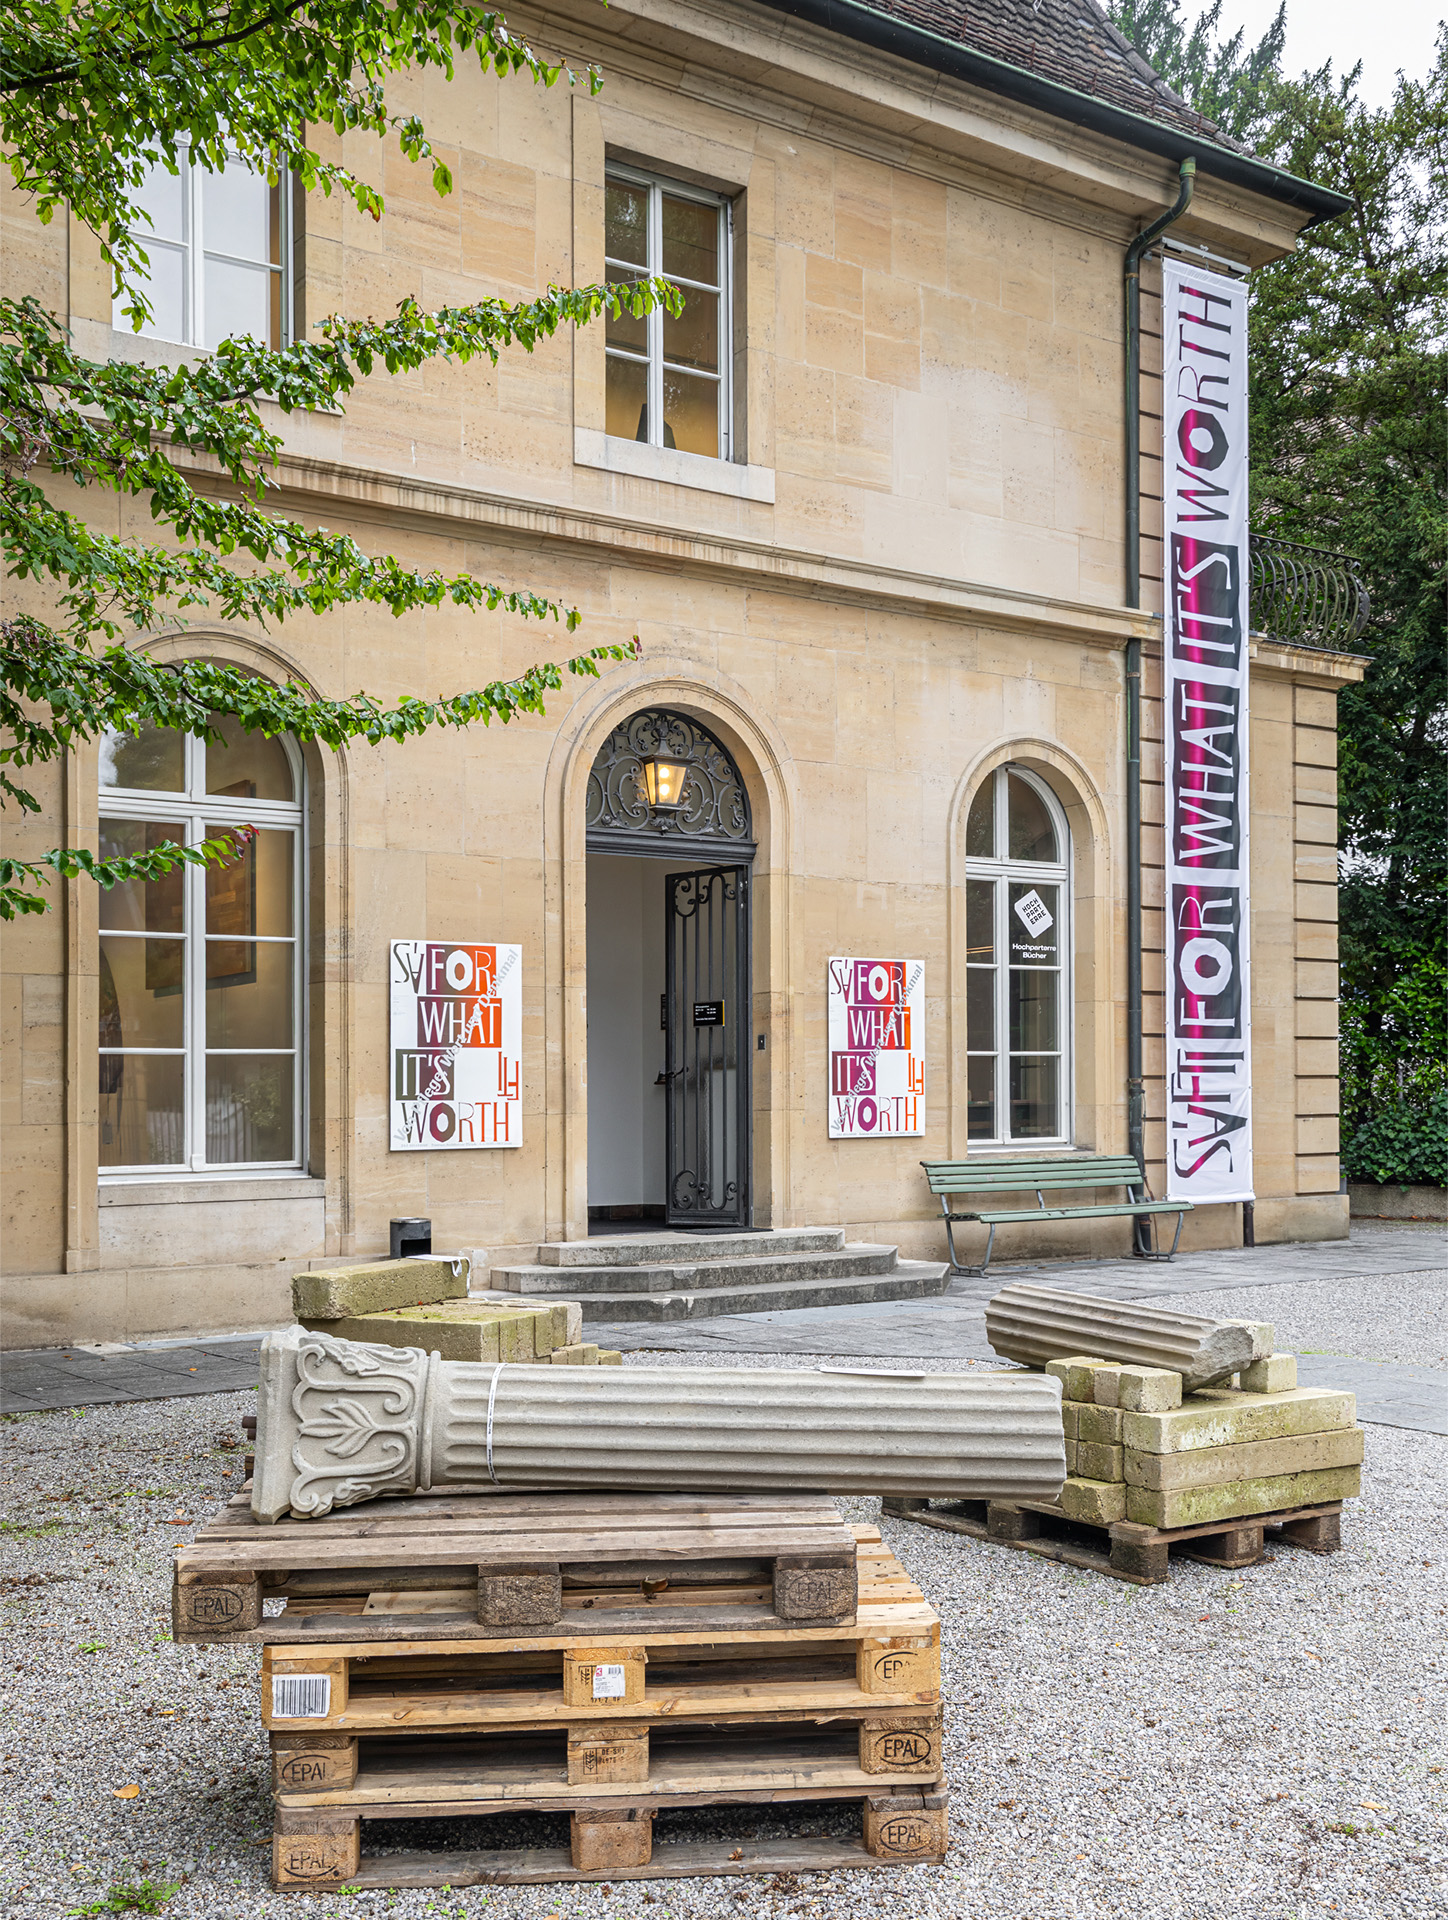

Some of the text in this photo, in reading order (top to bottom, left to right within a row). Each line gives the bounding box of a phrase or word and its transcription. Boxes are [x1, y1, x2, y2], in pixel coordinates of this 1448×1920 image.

[1176, 283, 1232, 523] WORTH
[1176, 546, 1236, 654] IT'S
[1178, 683, 1235, 861] WHAT
[1021, 897, 1039, 913] HOCH
[1025, 903, 1042, 919] PART
[1029, 909, 1047, 925] ERRE
[1012, 943, 1057, 952] Hochparterre
[1022, 951, 1047, 959] Bücher
[1178, 895, 1235, 1027] FOR
[430, 948, 493, 993] FOR
[857, 964, 904, 1002] FOR
[419, 1001, 501, 1044] WHAT
[440, 1031, 468, 1068] Wert
[462, 1006, 484, 1037] und
[477, 949, 519, 1007] Denkmal
[865, 1037, 886, 1067] Wert
[880, 1013, 899, 1040] und
[893, 965, 924, 1014] Denkmal
[849, 1009, 910, 1047] WHAT
[401, 1053, 451, 1096] IT'S
[836, 1055, 873, 1092] IT'S
[401, 1101, 509, 1143] WORTH
[836, 1096, 917, 1132] WORTH
[193, 1596, 235, 1617] EPAL
[884, 1739, 924, 1758] EPAL
